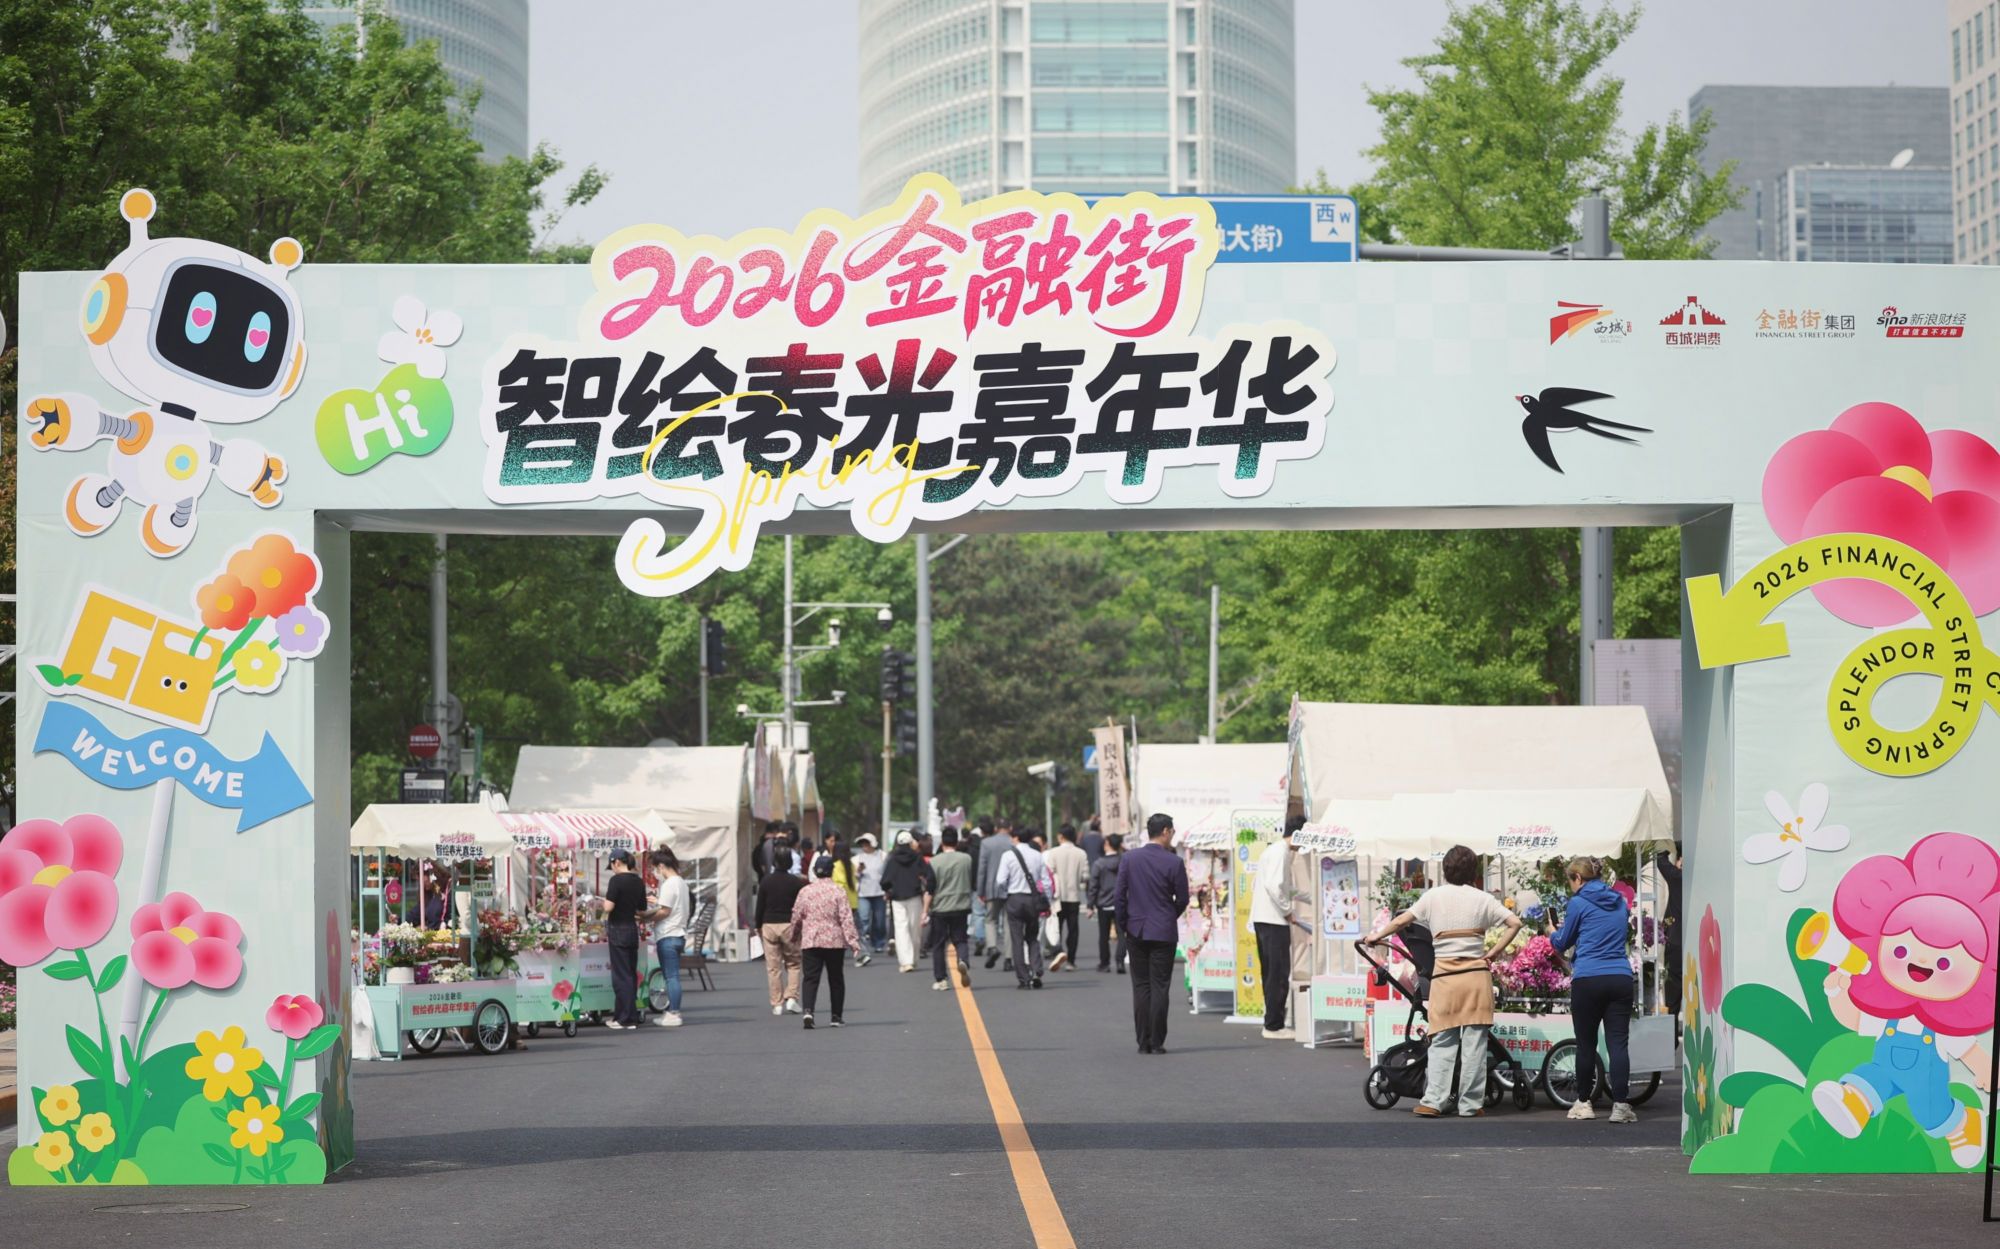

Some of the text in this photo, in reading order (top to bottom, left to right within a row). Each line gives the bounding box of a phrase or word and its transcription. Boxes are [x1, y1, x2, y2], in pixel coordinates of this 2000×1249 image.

[1316, 204, 1351, 223] 西 W
[600, 194, 1197, 341] 2026金融街
[1594, 318, 1627, 336] 西城
[1665, 331, 1721, 346] 西城消费
[1876, 312, 1967, 328] sina 新浪财经
[344, 389, 429, 461] Hi
[495, 336, 1319, 503] 智绘春光嘉年华
[633, 391, 982, 581] Spring
[1753, 556, 1809, 599] 2026
[1821, 545, 1946, 609] FINANCIAL
[1839, 641, 1935, 731] SPLENDOR
[1945, 616, 1972, 712] STREET
[71, 727, 244, 798] WELCOME
[1865, 721, 1956, 763] SPRING
